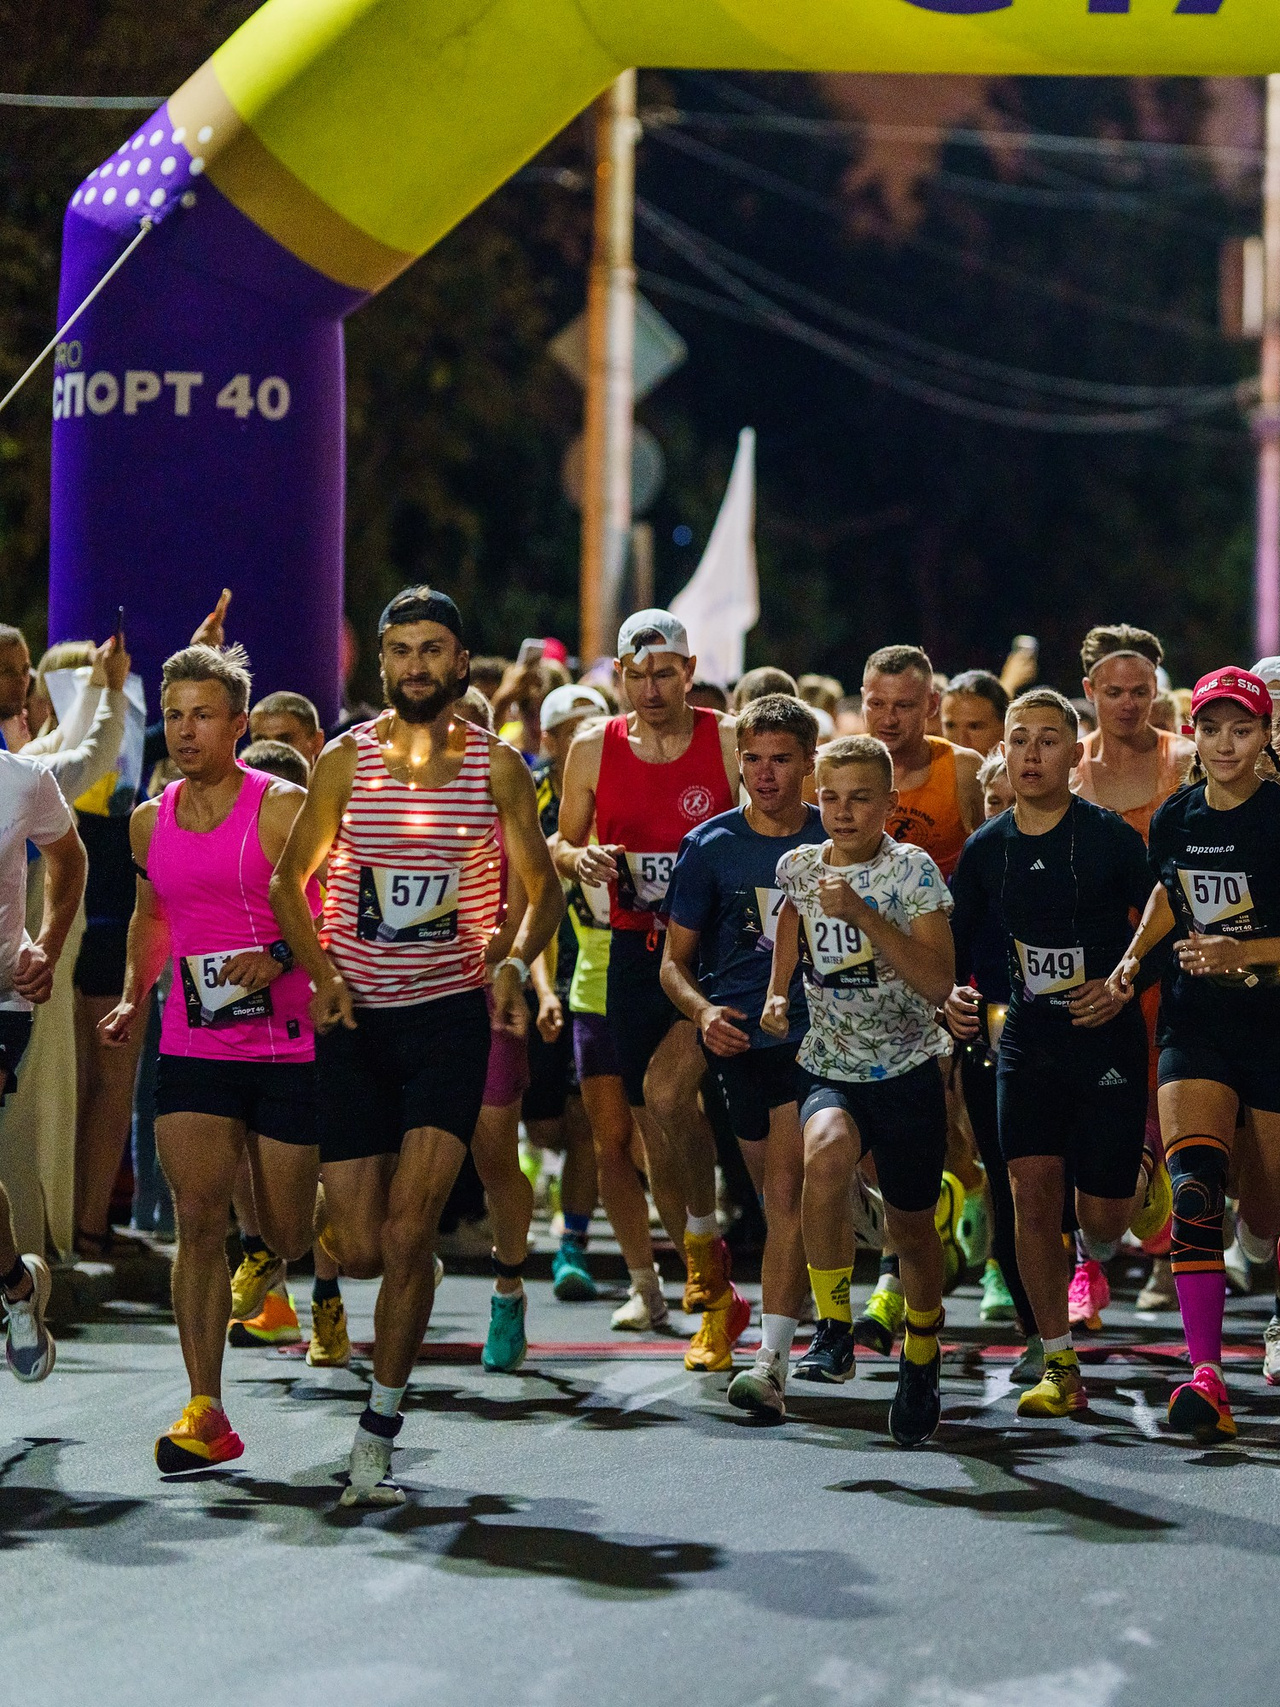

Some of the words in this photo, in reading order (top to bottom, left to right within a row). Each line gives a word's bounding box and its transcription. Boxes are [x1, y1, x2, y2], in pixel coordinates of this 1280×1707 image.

[52, 370, 204, 421] СПОРТ
[216, 373, 291, 421] 40
[1185, 844, 1235, 855] appzone.co
[641, 856, 674, 883] 53
[391, 873, 450, 907] 577
[1193, 874, 1242, 905] 570
[815, 921, 862, 954] 219
[1026, 948, 1075, 980] 549
